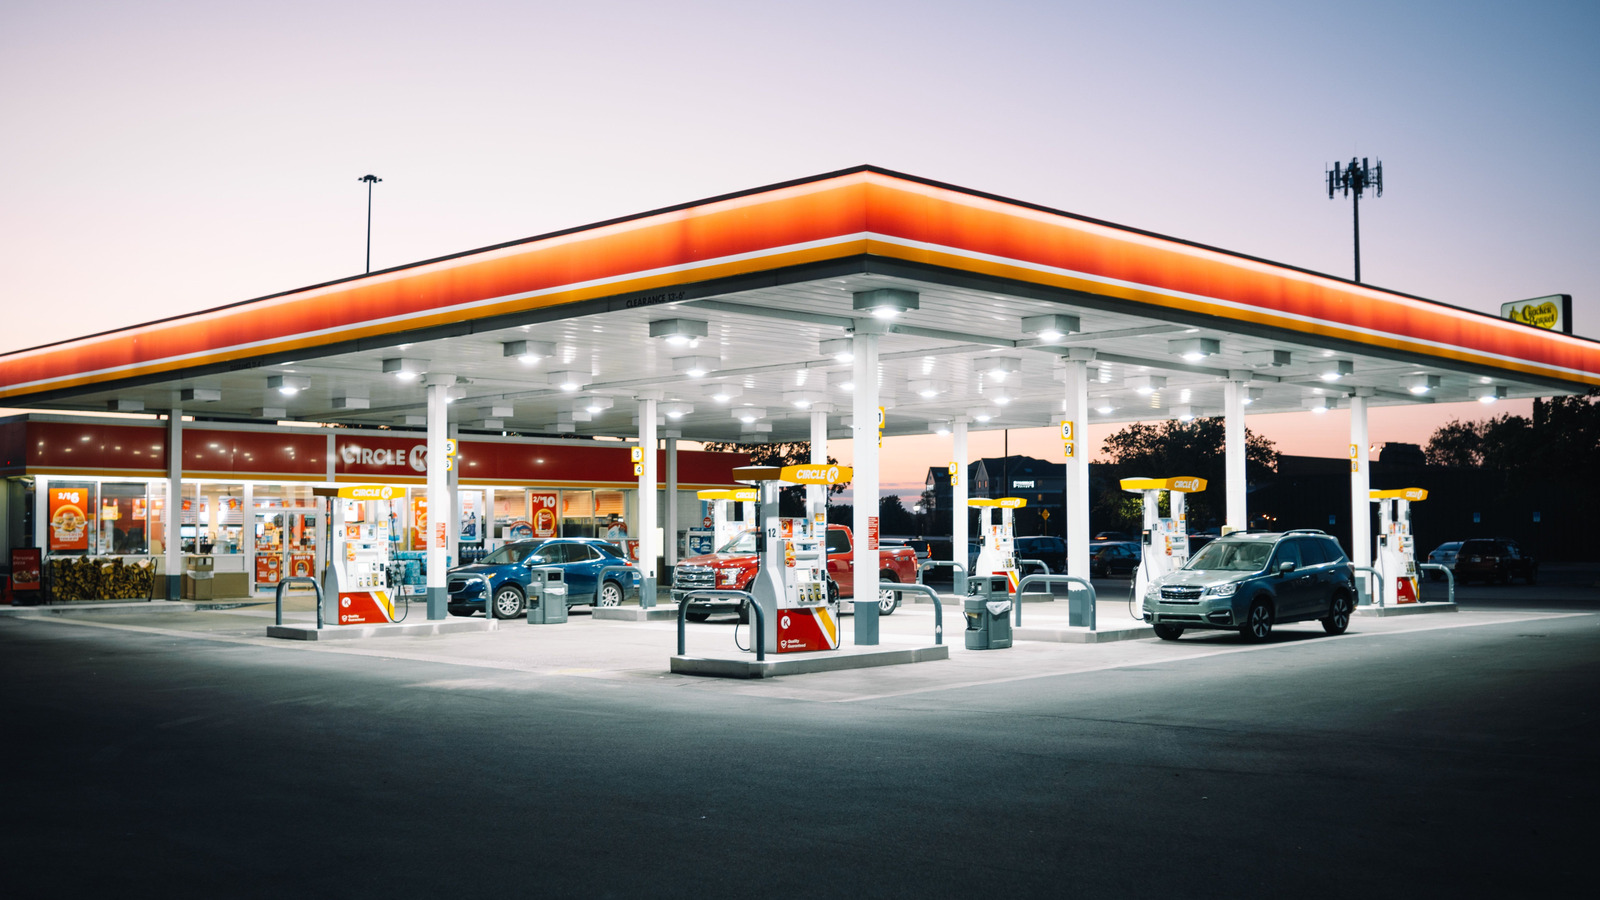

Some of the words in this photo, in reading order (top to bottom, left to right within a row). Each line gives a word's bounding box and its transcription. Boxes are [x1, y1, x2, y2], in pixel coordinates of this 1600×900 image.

[626, 294, 665, 308] CLEARANCE
[1522, 305, 1552, 321] Cracker
[1530, 314, 1554, 327] Barrel
[1064, 426, 1069, 434] 9
[635, 450, 640, 458] 3
[1065, 445, 1072, 454] 10
[342, 446, 406, 466] CIRCLE
[412, 447, 427, 472] K
[796, 469, 826, 479] CIRCLE
[828, 468, 838, 482] K
[1174, 480, 1192, 488] CIRCLE
[353, 489, 380, 497] CIRCLE
[382, 488, 391, 498] K
[768, 528, 776, 537] 12
[342, 598, 350, 607] K
[782, 616, 790, 629] K
